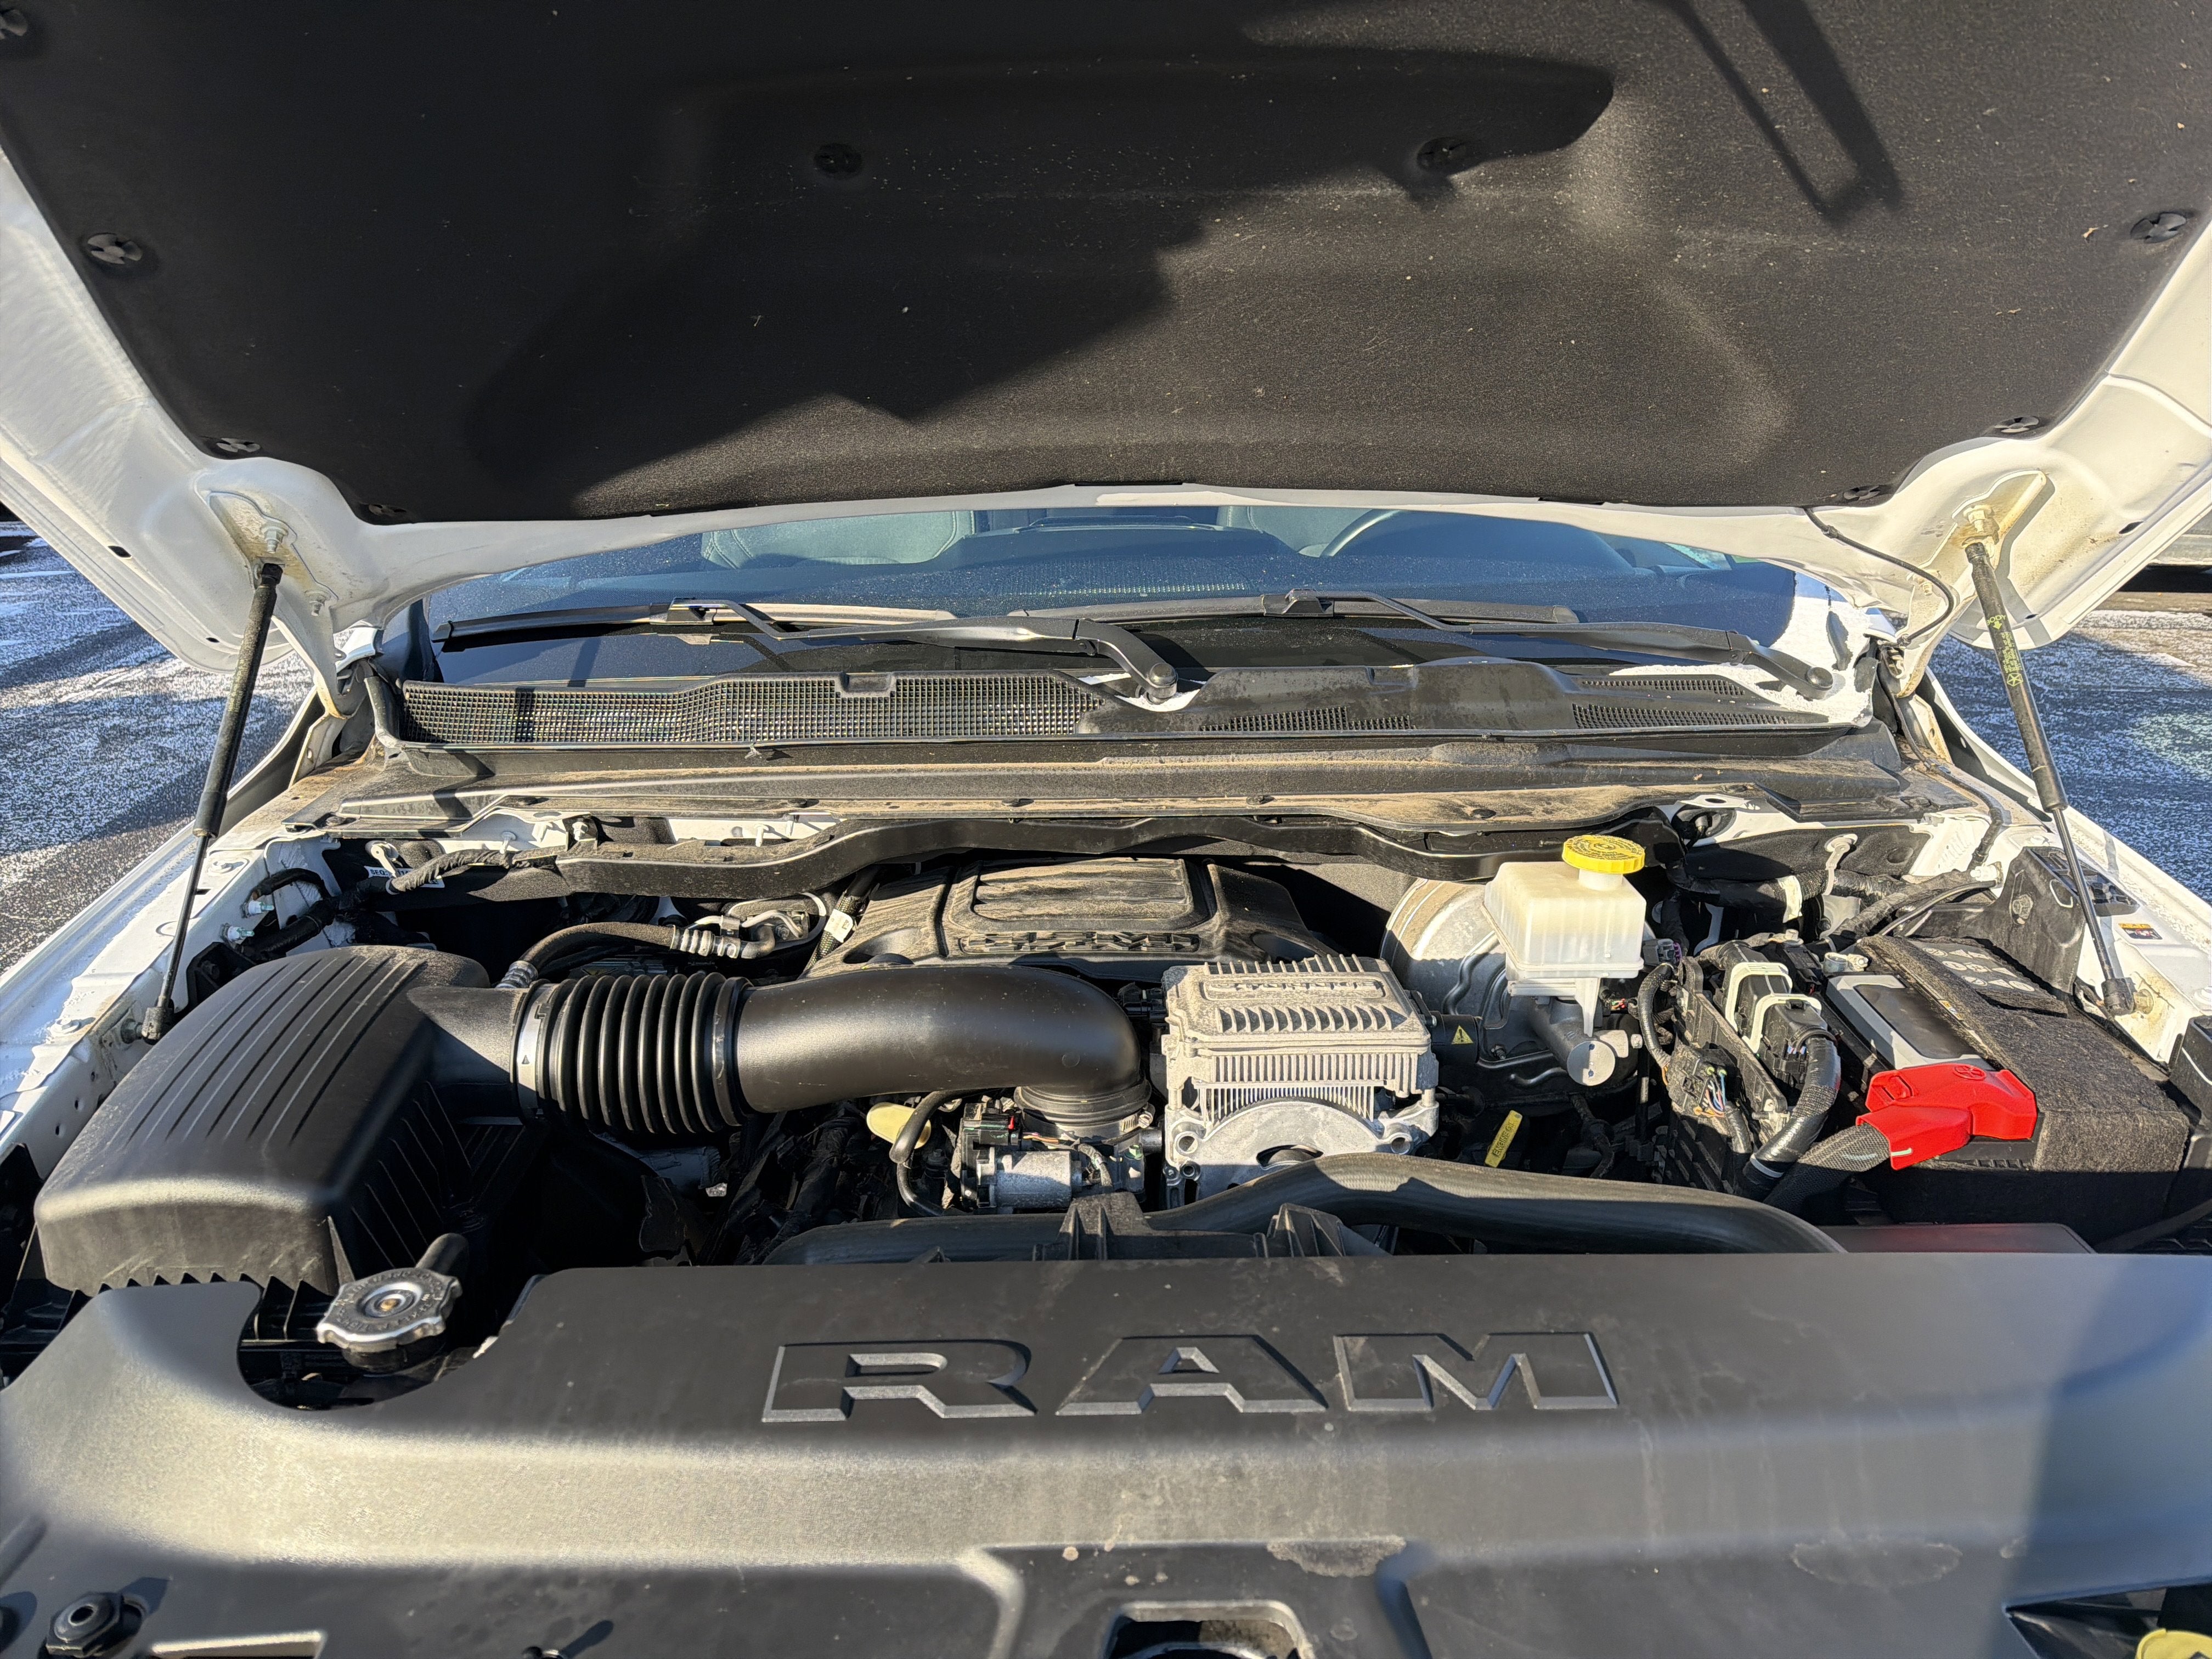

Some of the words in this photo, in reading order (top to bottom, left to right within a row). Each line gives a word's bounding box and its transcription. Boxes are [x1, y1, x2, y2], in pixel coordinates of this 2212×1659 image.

[1987, 614, 2006, 626] BODY
[1492, 1131, 1510, 1157] ENGINE
[1505, 1122, 1516, 1131] OIL
[761, 1331, 1620, 1422] RAM
